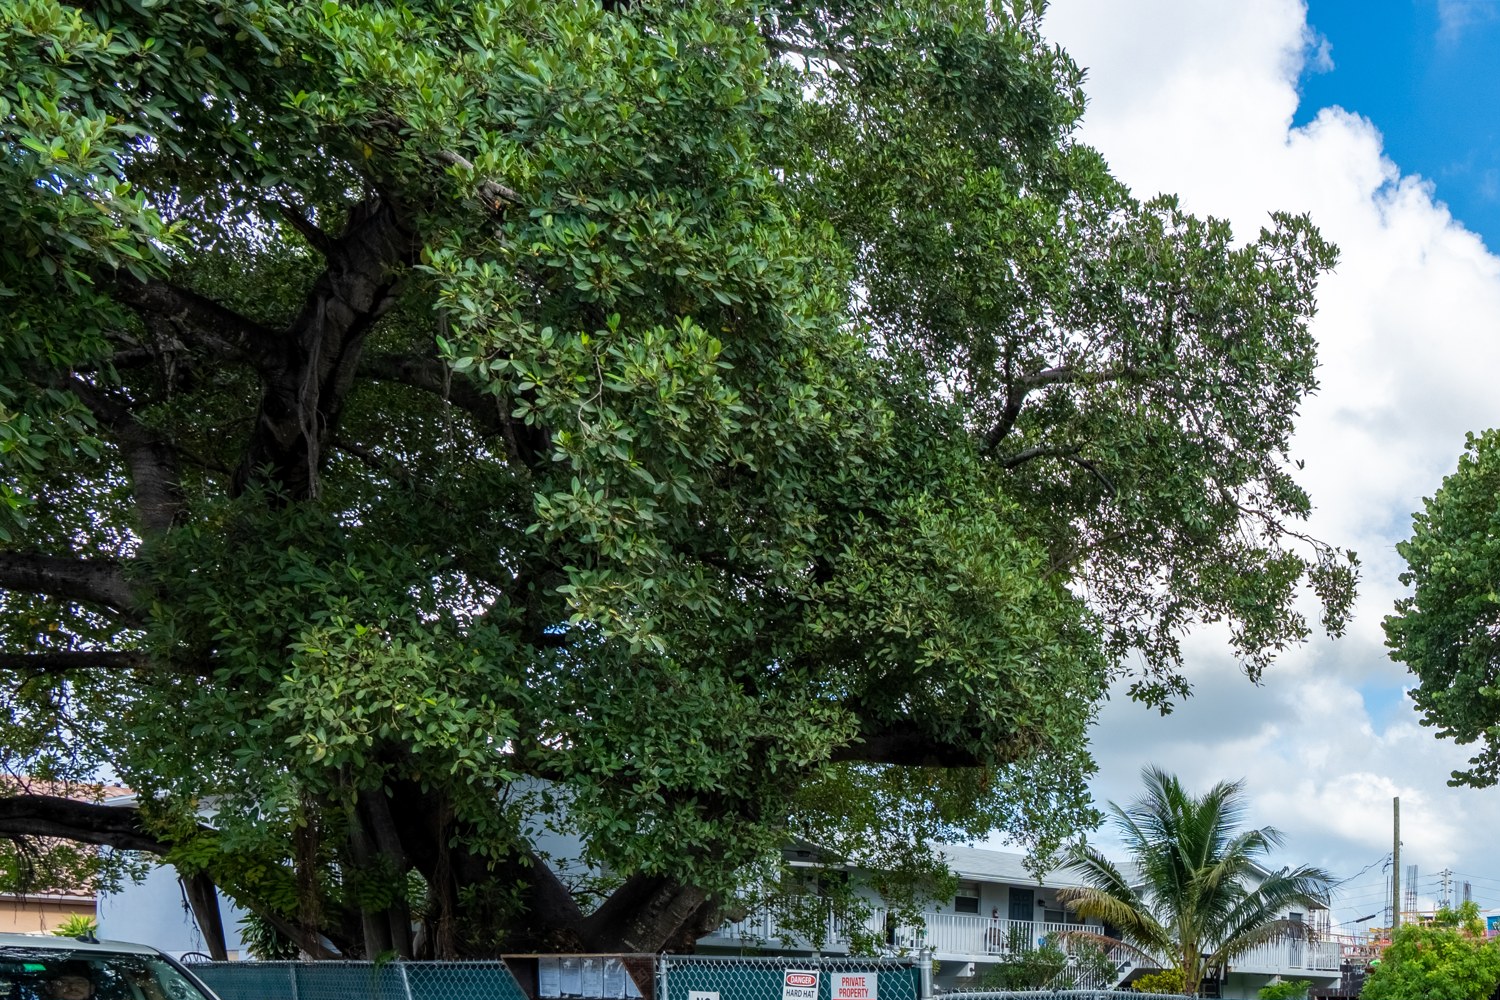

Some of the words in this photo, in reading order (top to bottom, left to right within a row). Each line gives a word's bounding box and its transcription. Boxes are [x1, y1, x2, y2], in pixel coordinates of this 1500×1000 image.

[790, 976, 812, 984] DANGER
[841, 977, 866, 987] PRIVATE
[785, 989, 802, 997] HARD
[803, 990, 815, 998] HAT
[838, 988, 869, 998] PROPERTY
